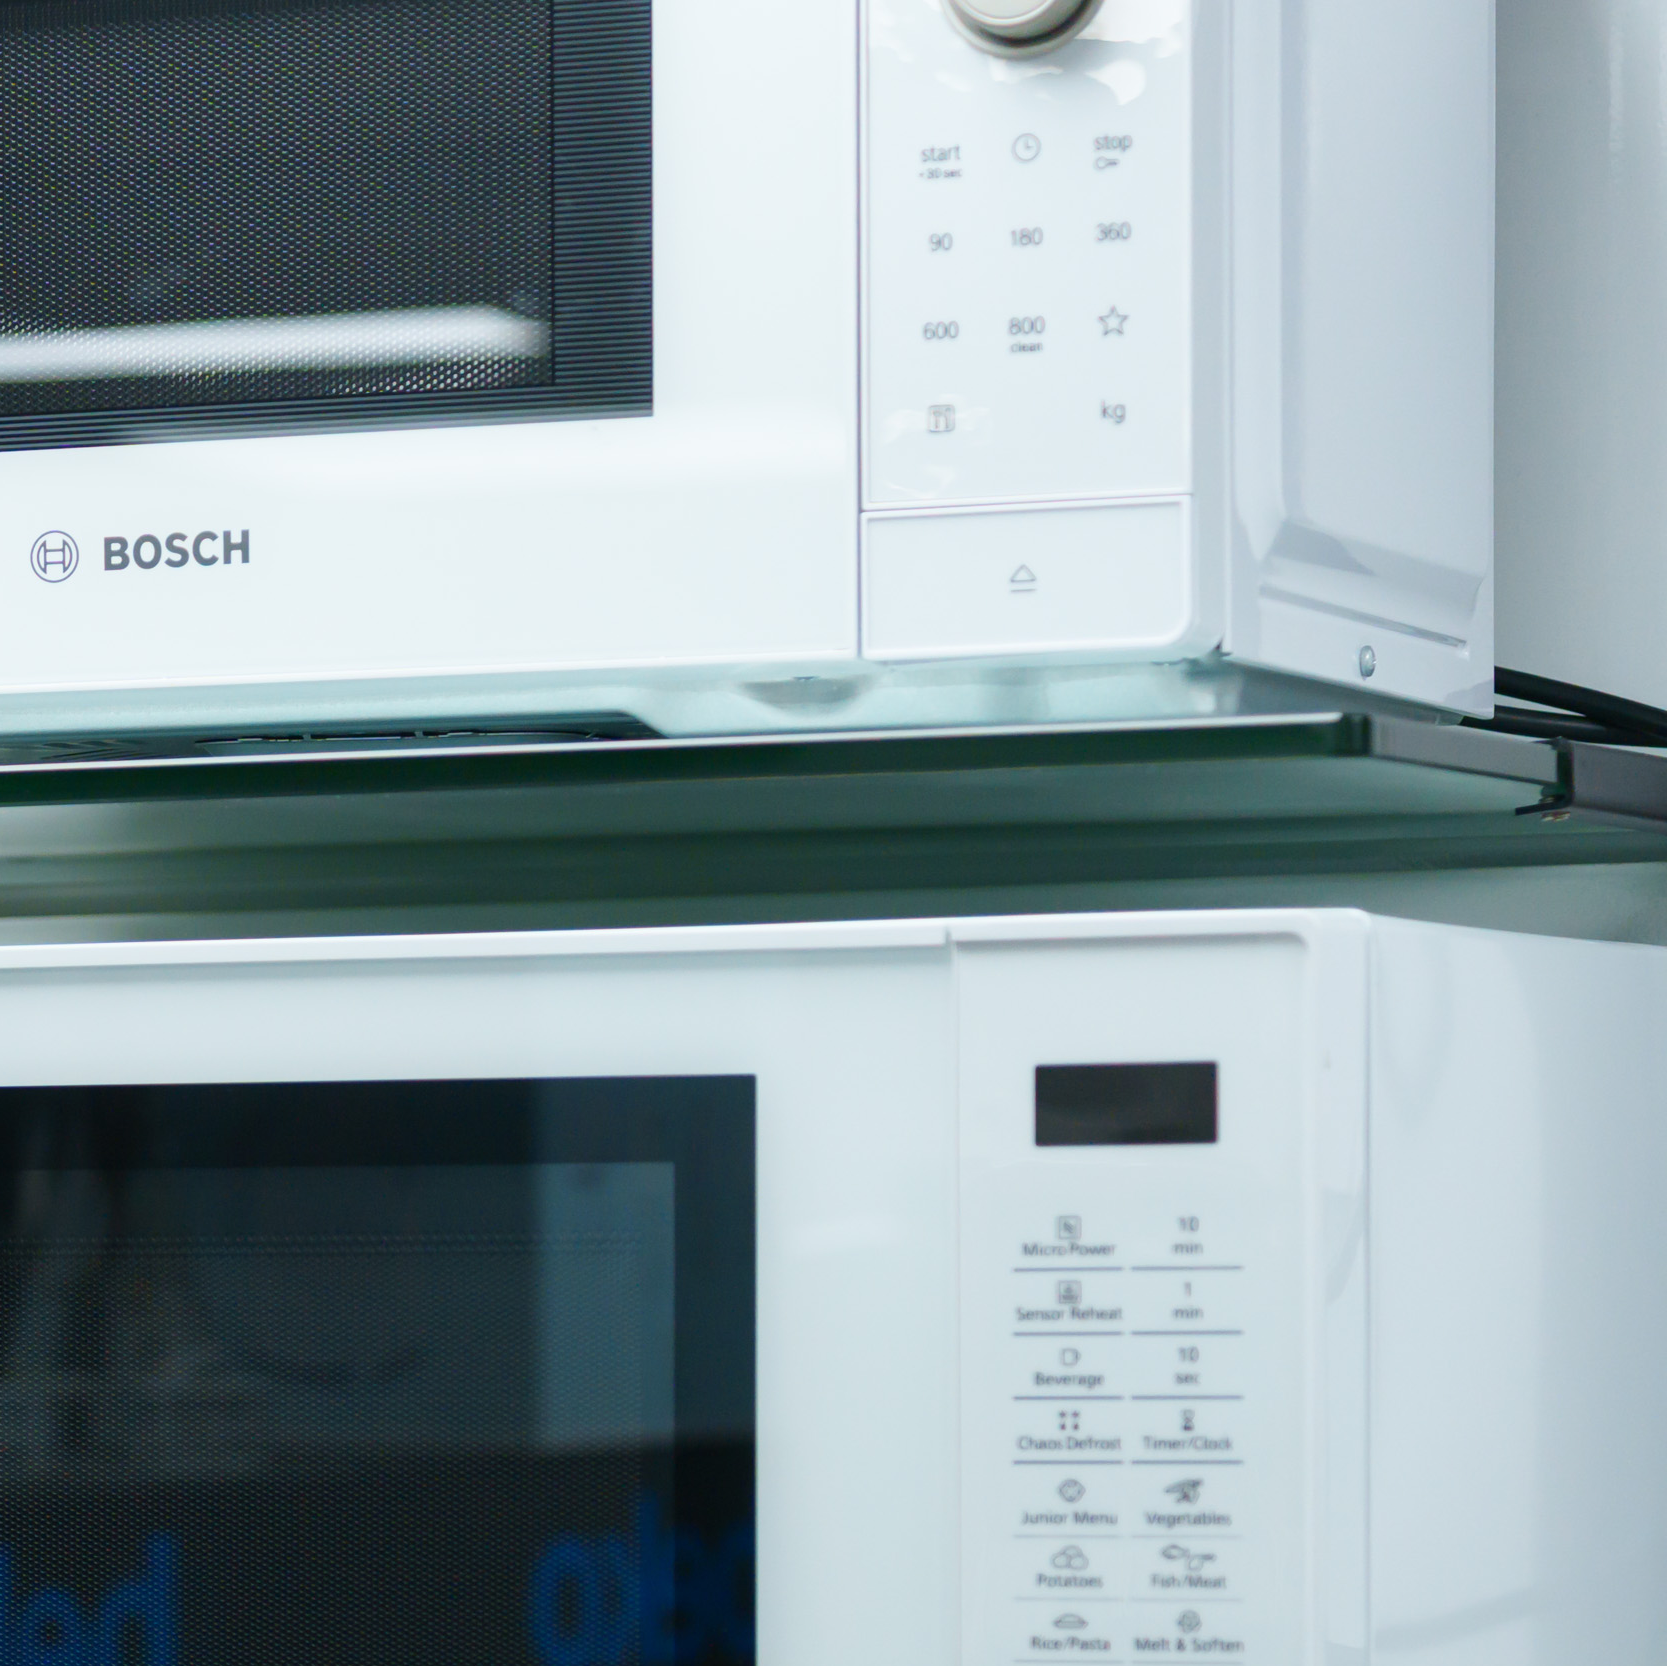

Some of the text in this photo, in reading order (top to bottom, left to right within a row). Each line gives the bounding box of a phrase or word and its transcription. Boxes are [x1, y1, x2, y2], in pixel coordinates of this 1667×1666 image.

[1095, 132, 1133, 153] stop
[921, 143, 962, 163] start
[1010, 226, 1044, 247] 180
[1096, 221, 1132, 242] 360
[929, 232, 954, 252] 90
[923, 320, 960, 341] 600
[1008, 316, 1046, 336] 800
[1010, 340, 1043, 354] clean
[1101, 400, 1126, 424] kg
[103, 528, 250, 571] BOSCH
[1178, 1216, 1199, 1232] 10
[1022, 1243, 1116, 1256] Micro Power
[1173, 1242, 1203, 1255] min
[1017, 1307, 1123, 1321] Sensor Reheat
[1173, 1306, 1203, 1319] min
[1178, 1346, 1199, 1362] 10
[1034, 1371, 1104, 1389] Beverage
[1175, 1373, 1200, 1385] sec
[1017, 1436, 1121, 1451] Chaos Defrost
[1143, 1436, 1233, 1451] Timer/Clock
[1021, 1511, 1118, 1526] Junior Menu
[1145, 1511, 1232, 1529] Vegetables
[1036, 1573, 1103, 1588] Potatoes
[1150, 1573, 1226, 1589] Fish/Meat
[1030, 1635, 1111, 1651] Rice/Pasta
[1134, 1637, 1170, 1652] Melt
[1193, 1637, 1244, 1652] Soften
